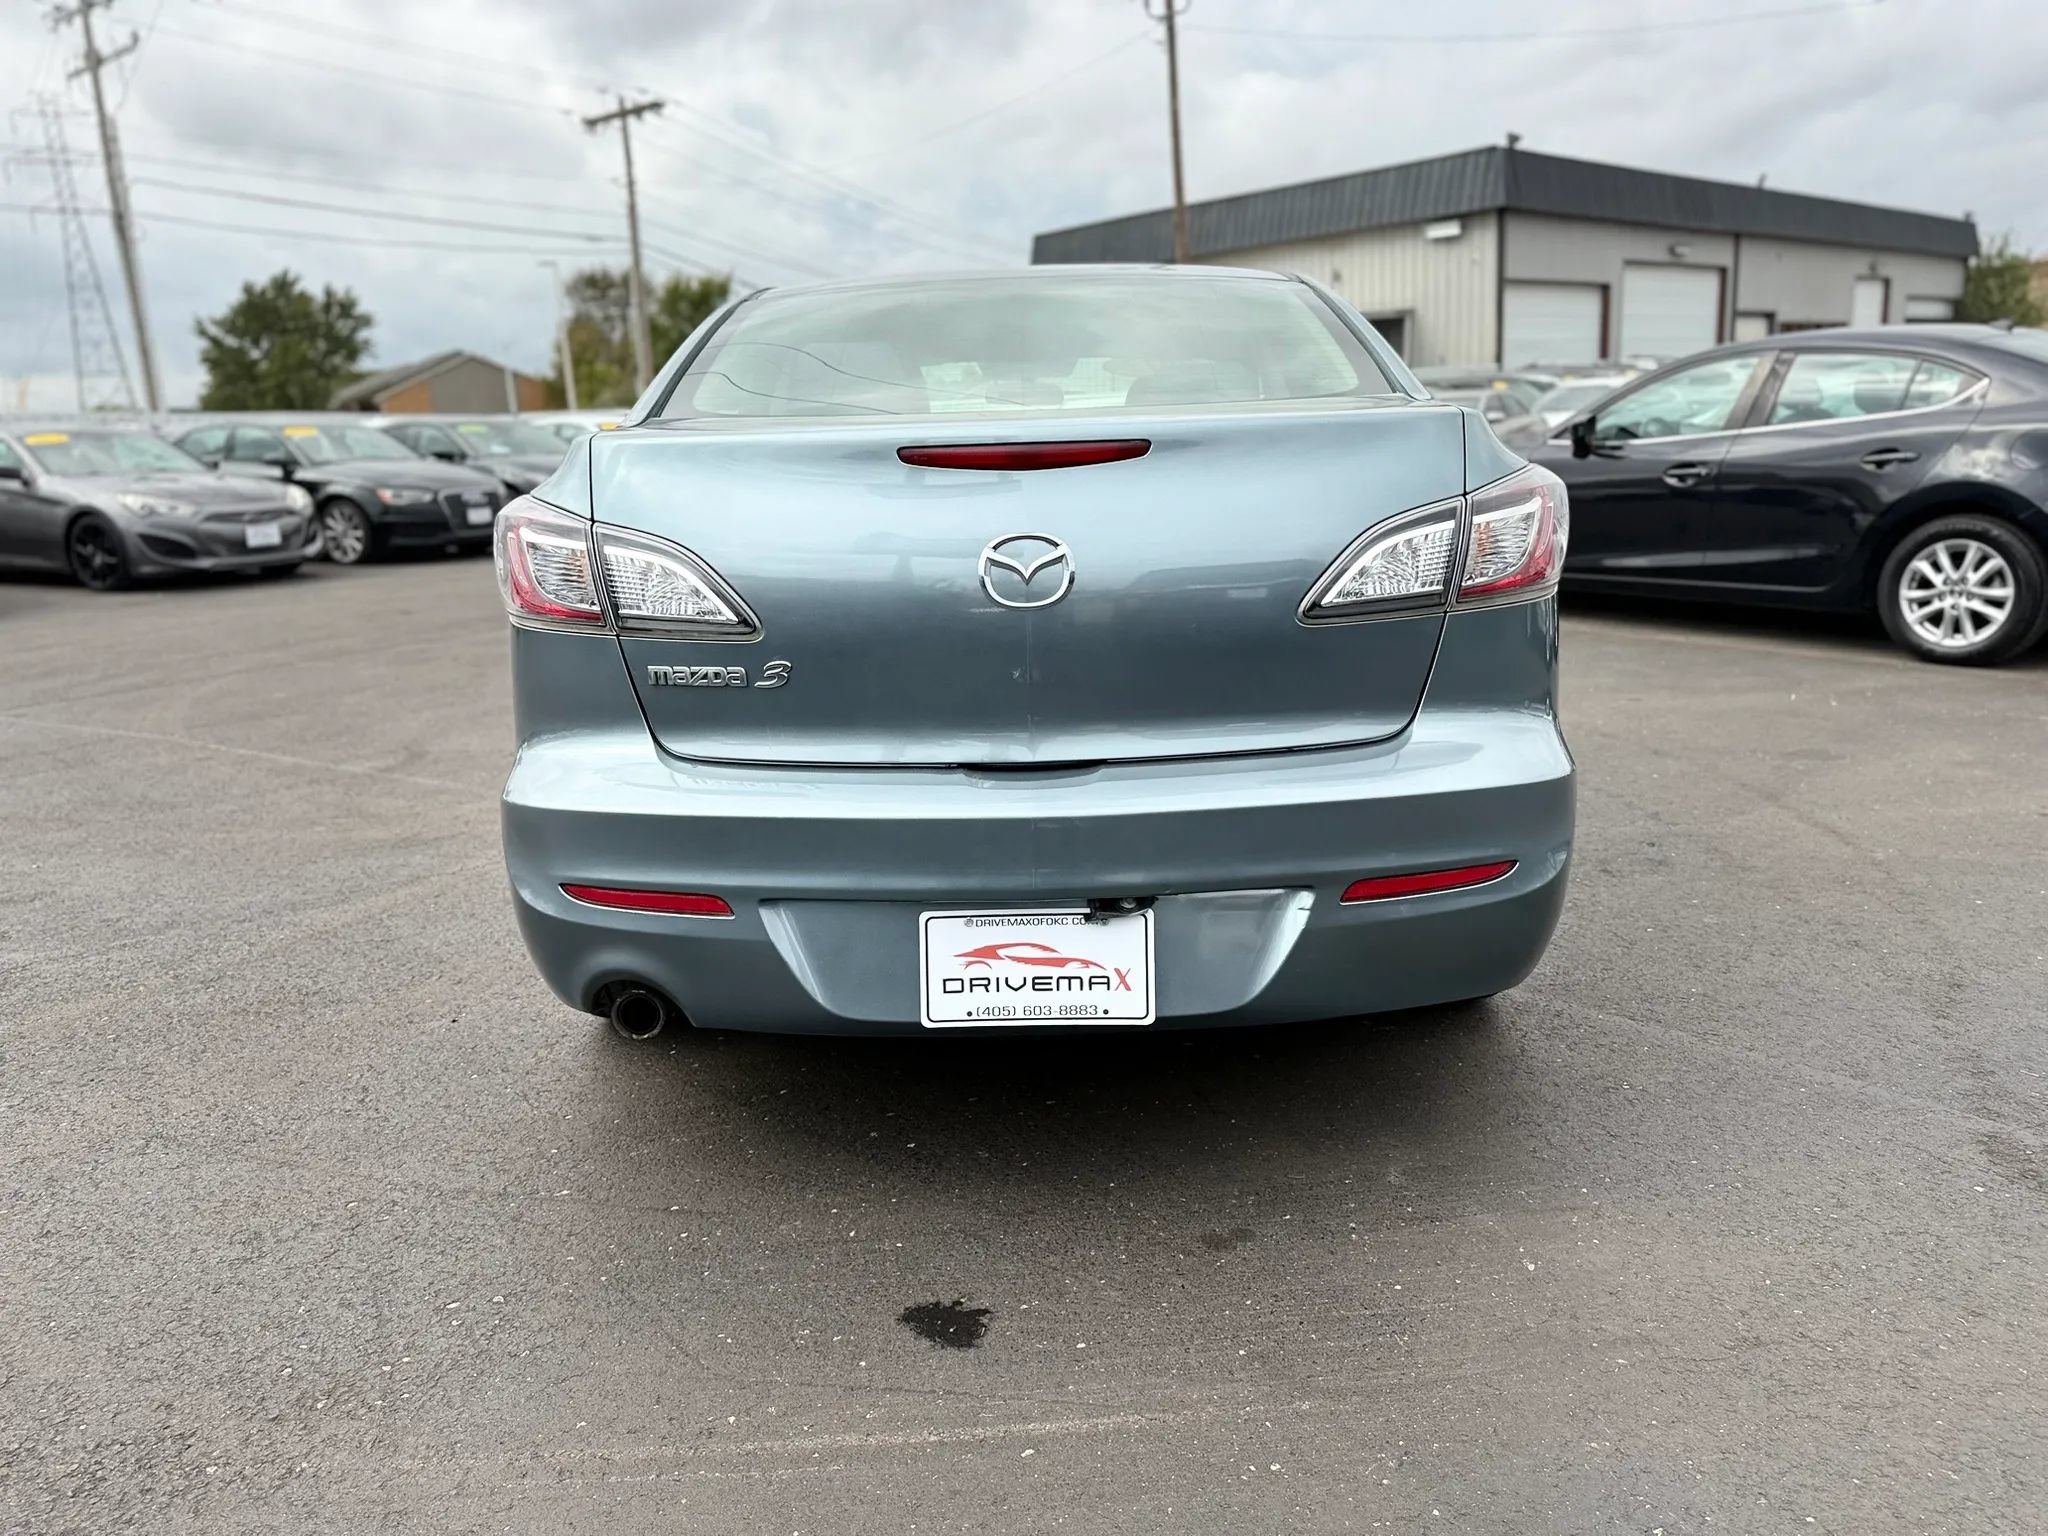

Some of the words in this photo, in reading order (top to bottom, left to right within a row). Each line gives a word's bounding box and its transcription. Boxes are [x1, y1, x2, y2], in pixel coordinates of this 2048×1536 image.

[754, 660, 792, 689] 3
[975, 916, 1098, 928] DRIVEMAXOFOKC.CO
[943, 968, 1132, 994] DRIVEMAX
[976, 1006, 1016, 1017] (405)
[1023, 1005, 1098, 1016] 603-8883
